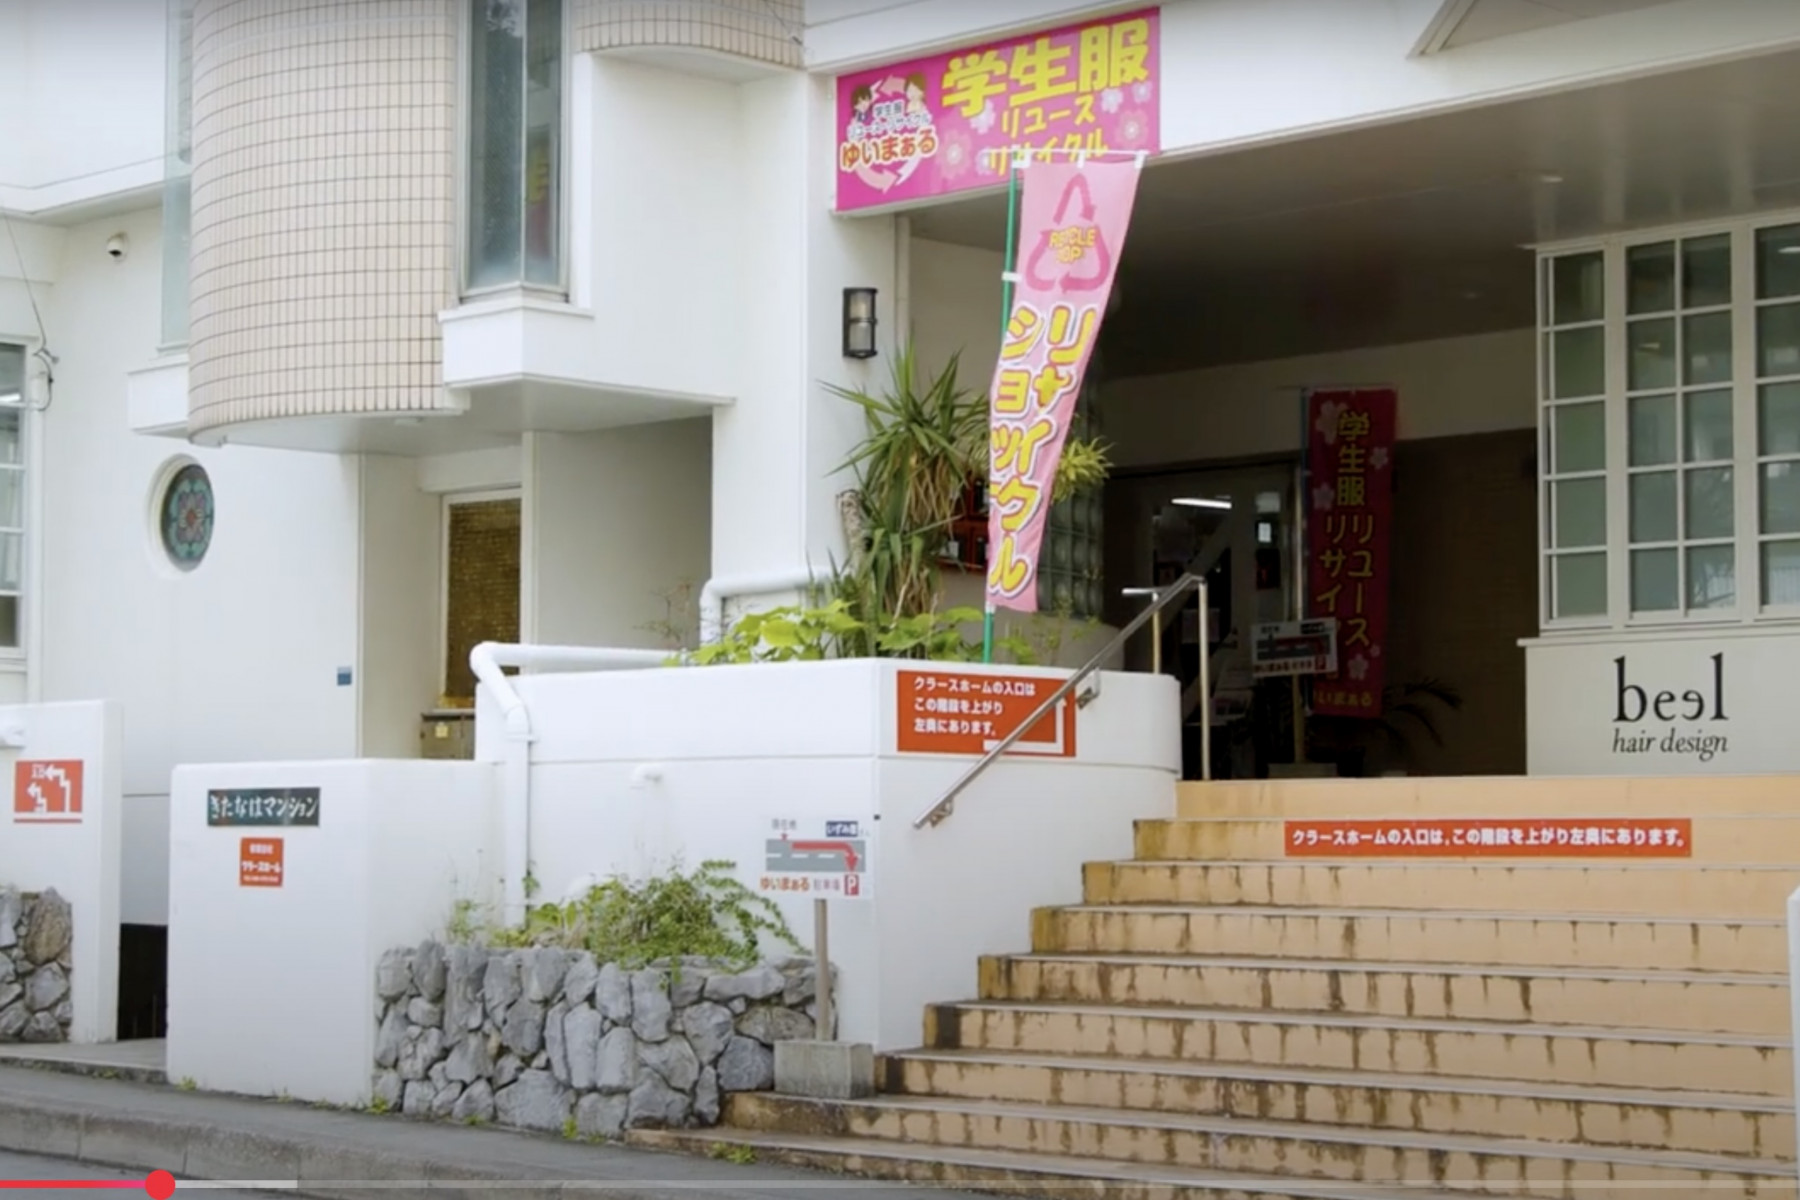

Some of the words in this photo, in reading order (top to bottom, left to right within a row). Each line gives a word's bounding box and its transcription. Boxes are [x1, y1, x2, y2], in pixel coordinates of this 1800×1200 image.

[942, 18, 1150, 118] 学生服
[1001, 93, 1097, 139] リユース
[1336, 410, 1371, 507] 学生服
[1343, 512, 1376, 648] リユース
[1612, 727, 1656, 753] hair
[1660, 727, 1729, 762] design
[209, 795, 319, 820] きたなはマンション
